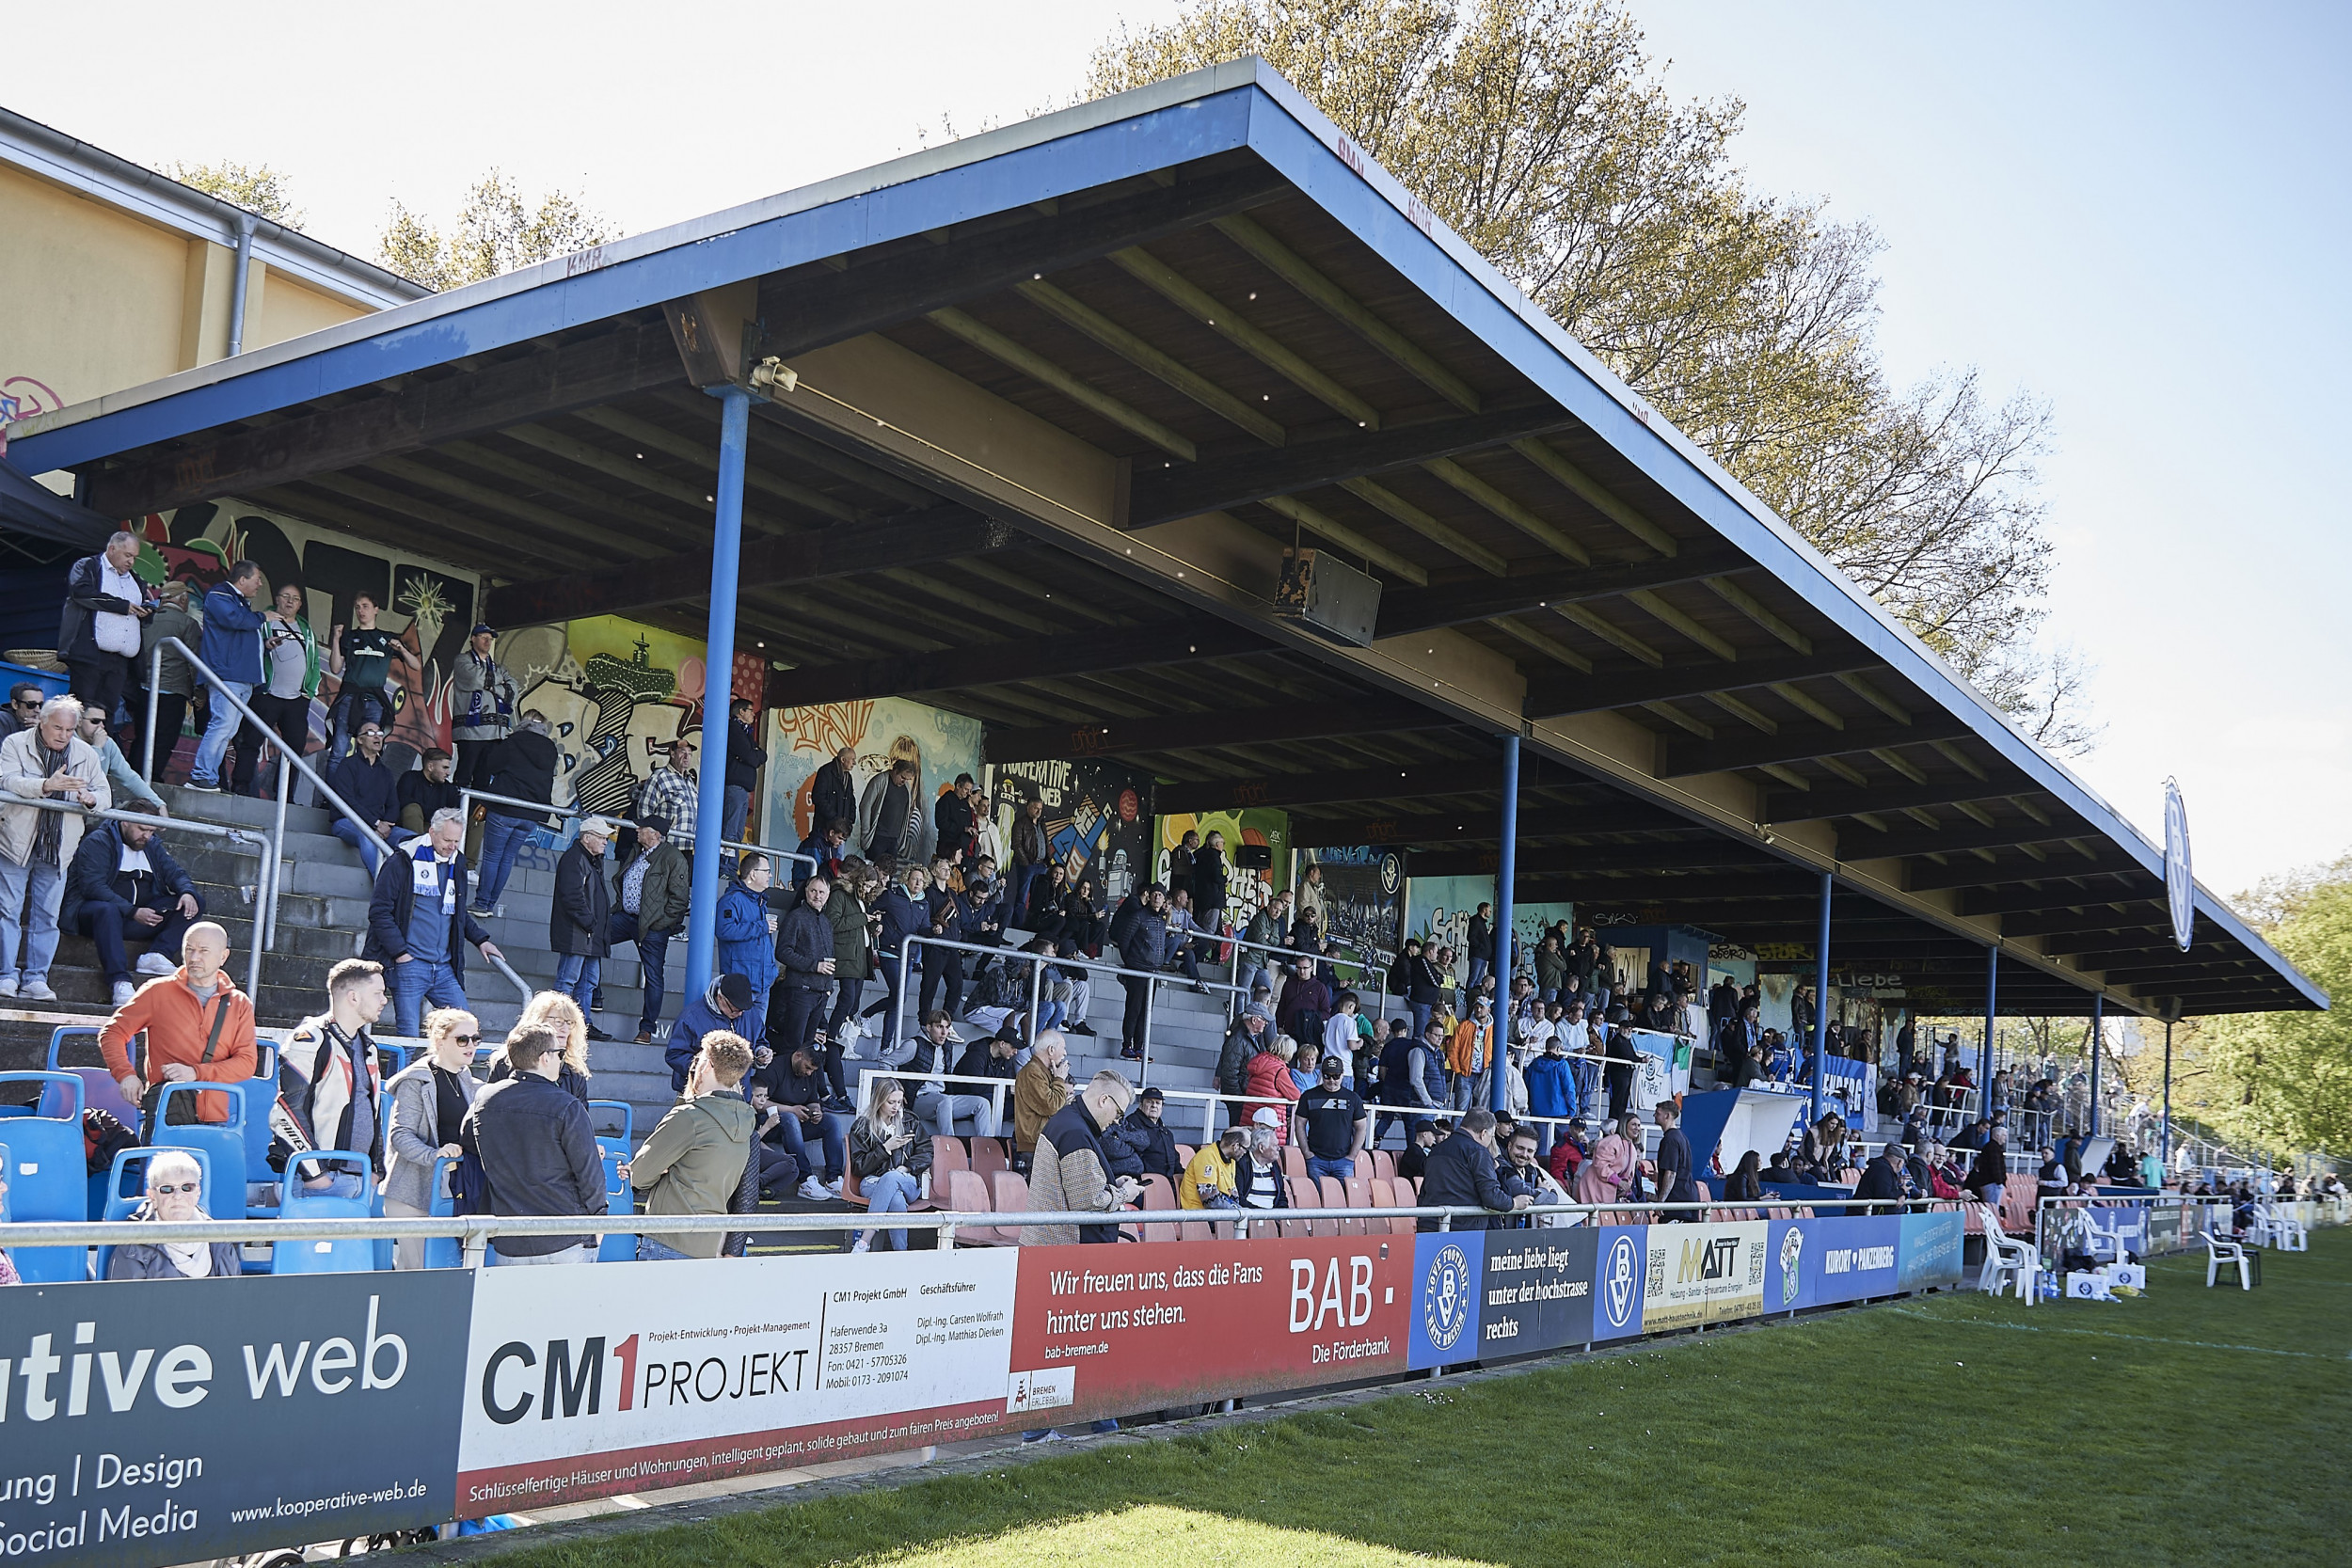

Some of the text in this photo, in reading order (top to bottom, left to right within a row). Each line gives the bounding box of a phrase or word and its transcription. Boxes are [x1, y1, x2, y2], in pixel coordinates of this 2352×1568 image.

[1039, 784, 1061, 808] WEB
[1428, 1248, 1468, 1295] LOVE FOOTBALL
[1490, 1246, 1569, 1273] meine liebe liegt
[1677, 1237, 1740, 1284] MATT
[1825, 1245, 1895, 1275] KURORT PANZENBERG
[920, 1282, 977, 1295] Geschäftsführer
[1050, 1261, 1263, 1296] Wir freuen uns, dass die Fans
[1488, 1277, 1588, 1306] unter der hochstrasse
[1669, 1287, 1685, 1301] Heizung
[1727, 1282, 1743, 1293] Energien
[834, 1288, 908, 1304] CM1 Projekt GmbH
[1289, 1255, 1375, 1334] BAB
[830, 1323, 888, 1338] Haferwende 3a
[917, 1315, 948, 1328] Dipl.-Ing.
[949, 1314, 975, 1326] Carsten
[1046, 1302, 1186, 1335] hinter uns stehen.
[1427, 1310, 1464, 1346] HATE RACISM
[1486, 1316, 1518, 1339] rechts
[648, 1327, 728, 1344] Projekt-Entwicklung
[734, 1321, 810, 1336] Projekt-Management
[915, 1327, 1004, 1345] Dipl.-Ing. Matthias Dierken
[243, 1294, 409, 1401] web
[829, 1340, 883, 1354] 28357 Bremen
[1044, 1340, 1109, 1359] bab-bremen.de
[1312, 1336, 1391, 1364] Die Förderbank
[827, 1360, 844, 1372] Fon:
[846, 1358, 864, 1370] 0421
[871, 1354, 907, 1369] 57705326
[482, 1334, 808, 1424] CM1 PROJEKT
[826, 1375, 850, 1389] Mobil:
[851, 1374, 870, 1386] 0173
[877, 1370, 909, 1385] 2091074
[1032, 1385, 1057, 1396] BREMEN
[469, 1410, 999, 1502] Schlüsselfertige Häuser und Wohnungen, intelligent geplant, solide gebaut und zum fairen Preis angeboten!
[97, 1453, 203, 1488] Design
[230, 1481, 427, 1524] www.kooperative-web.de
[99, 1498, 198, 1543] Media
